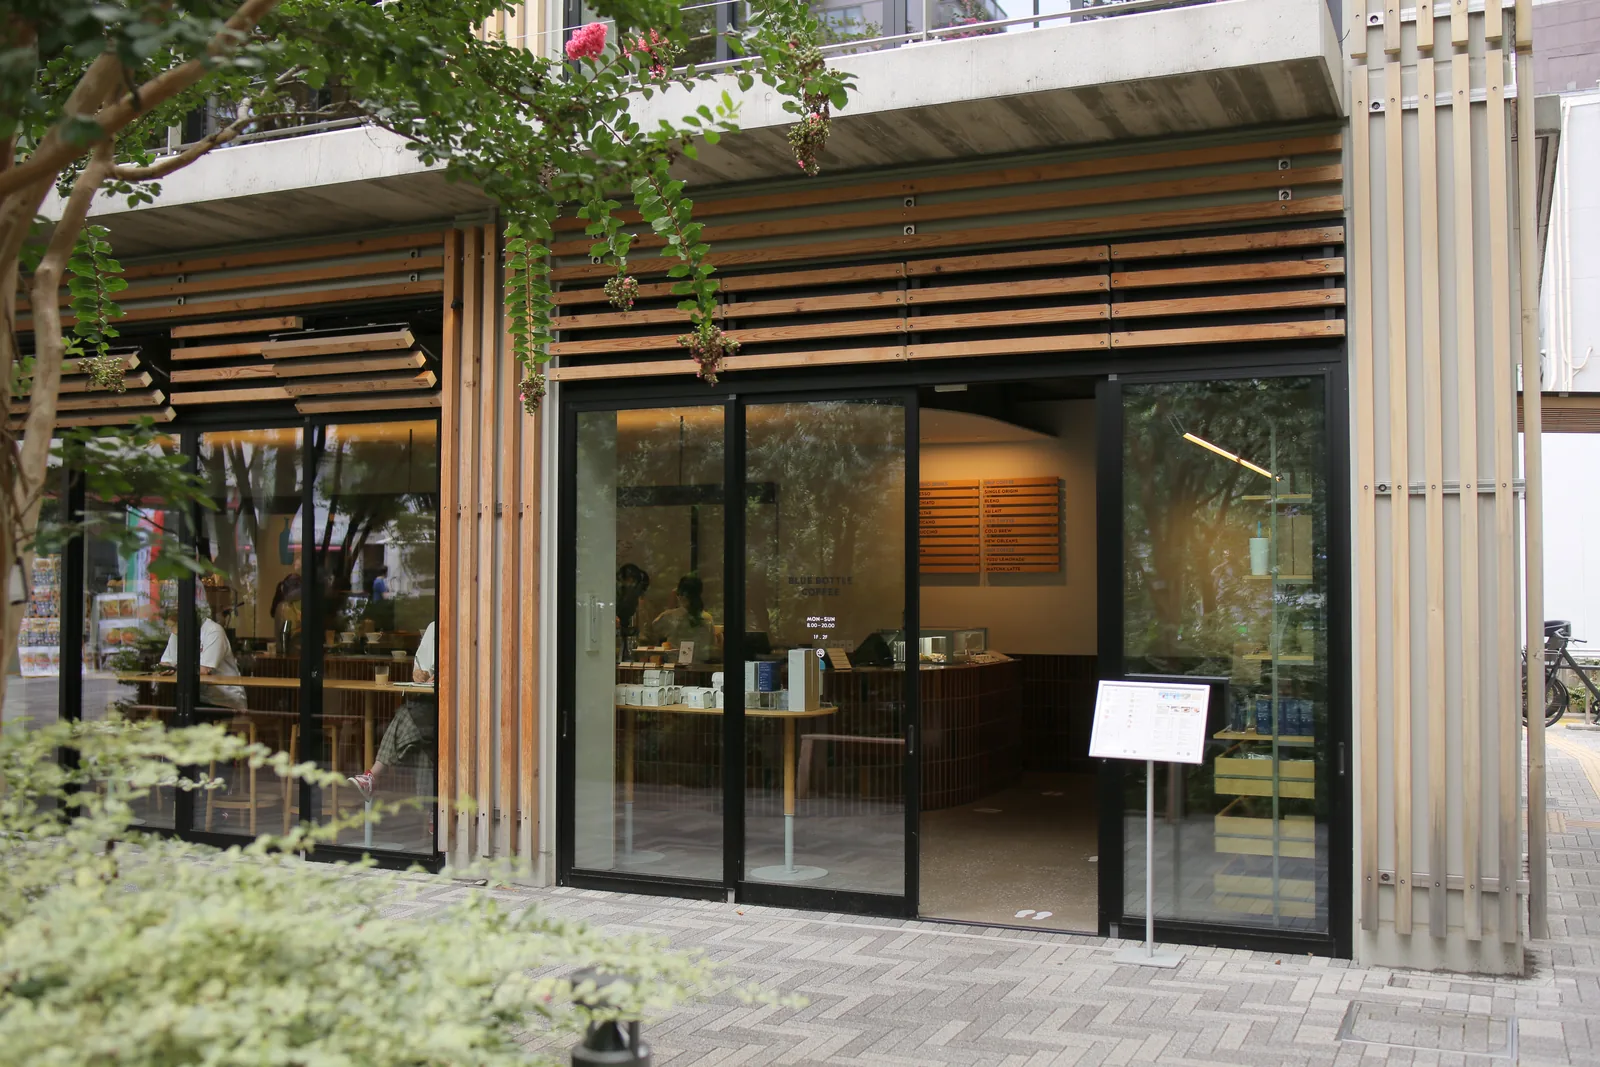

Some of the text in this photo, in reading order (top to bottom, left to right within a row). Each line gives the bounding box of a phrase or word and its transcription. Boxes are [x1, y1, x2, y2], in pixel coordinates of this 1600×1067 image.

[788, 576, 852, 585] BLUE BOTTLE
[802, 588, 840, 596] COFFEE
